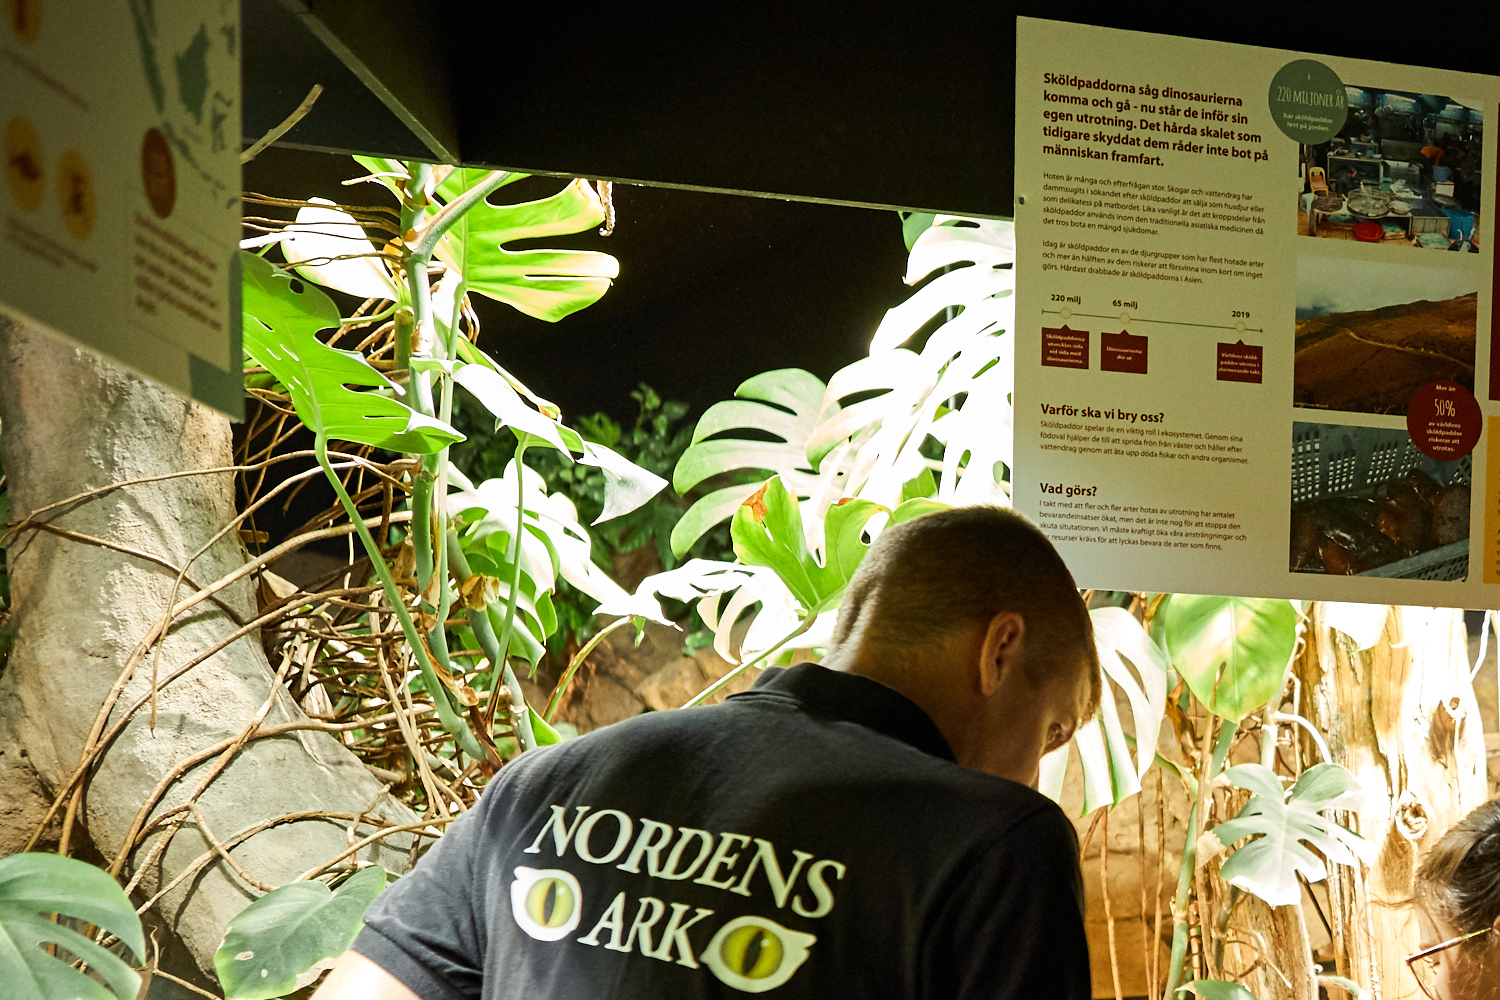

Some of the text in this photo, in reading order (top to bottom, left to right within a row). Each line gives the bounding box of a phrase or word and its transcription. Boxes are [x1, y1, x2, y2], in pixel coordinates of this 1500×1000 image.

[1043, 72, 1243, 107] Sköldpaddorna såg dinosaurierna
[1276, 86, 1345, 109] 220 MILJONER ÅR
[1043, 89, 1089, 106] komma
[1091, 96, 1113, 109] och
[1115, 98, 1131, 113] gå
[1140, 104, 1156, 114] nu
[1158, 104, 1182, 117] står
[1183, 106, 1199, 119] de
[1200, 108, 1230, 123] inför
[1231, 112, 1248, 125] sin
[1294, 114, 1333, 124] sköldpaddor
[1042, 110, 1262, 143] egen utrotning. Det hårda skalet som
[1042, 125, 1269, 163] tidigare skyddat dem råder inte bot på
[1042, 143, 1164, 167] människan framfart.
[1050, 293, 1082, 305] 220 milj
[1040, 403, 1165, 424] Varför ska vi bry oss?
[1434, 398, 1456, 417] 50%
[1039, 482, 1098, 498] Vad görs?
[523, 804, 846, 919] NORDENS
[577, 891, 715, 969] ARK
